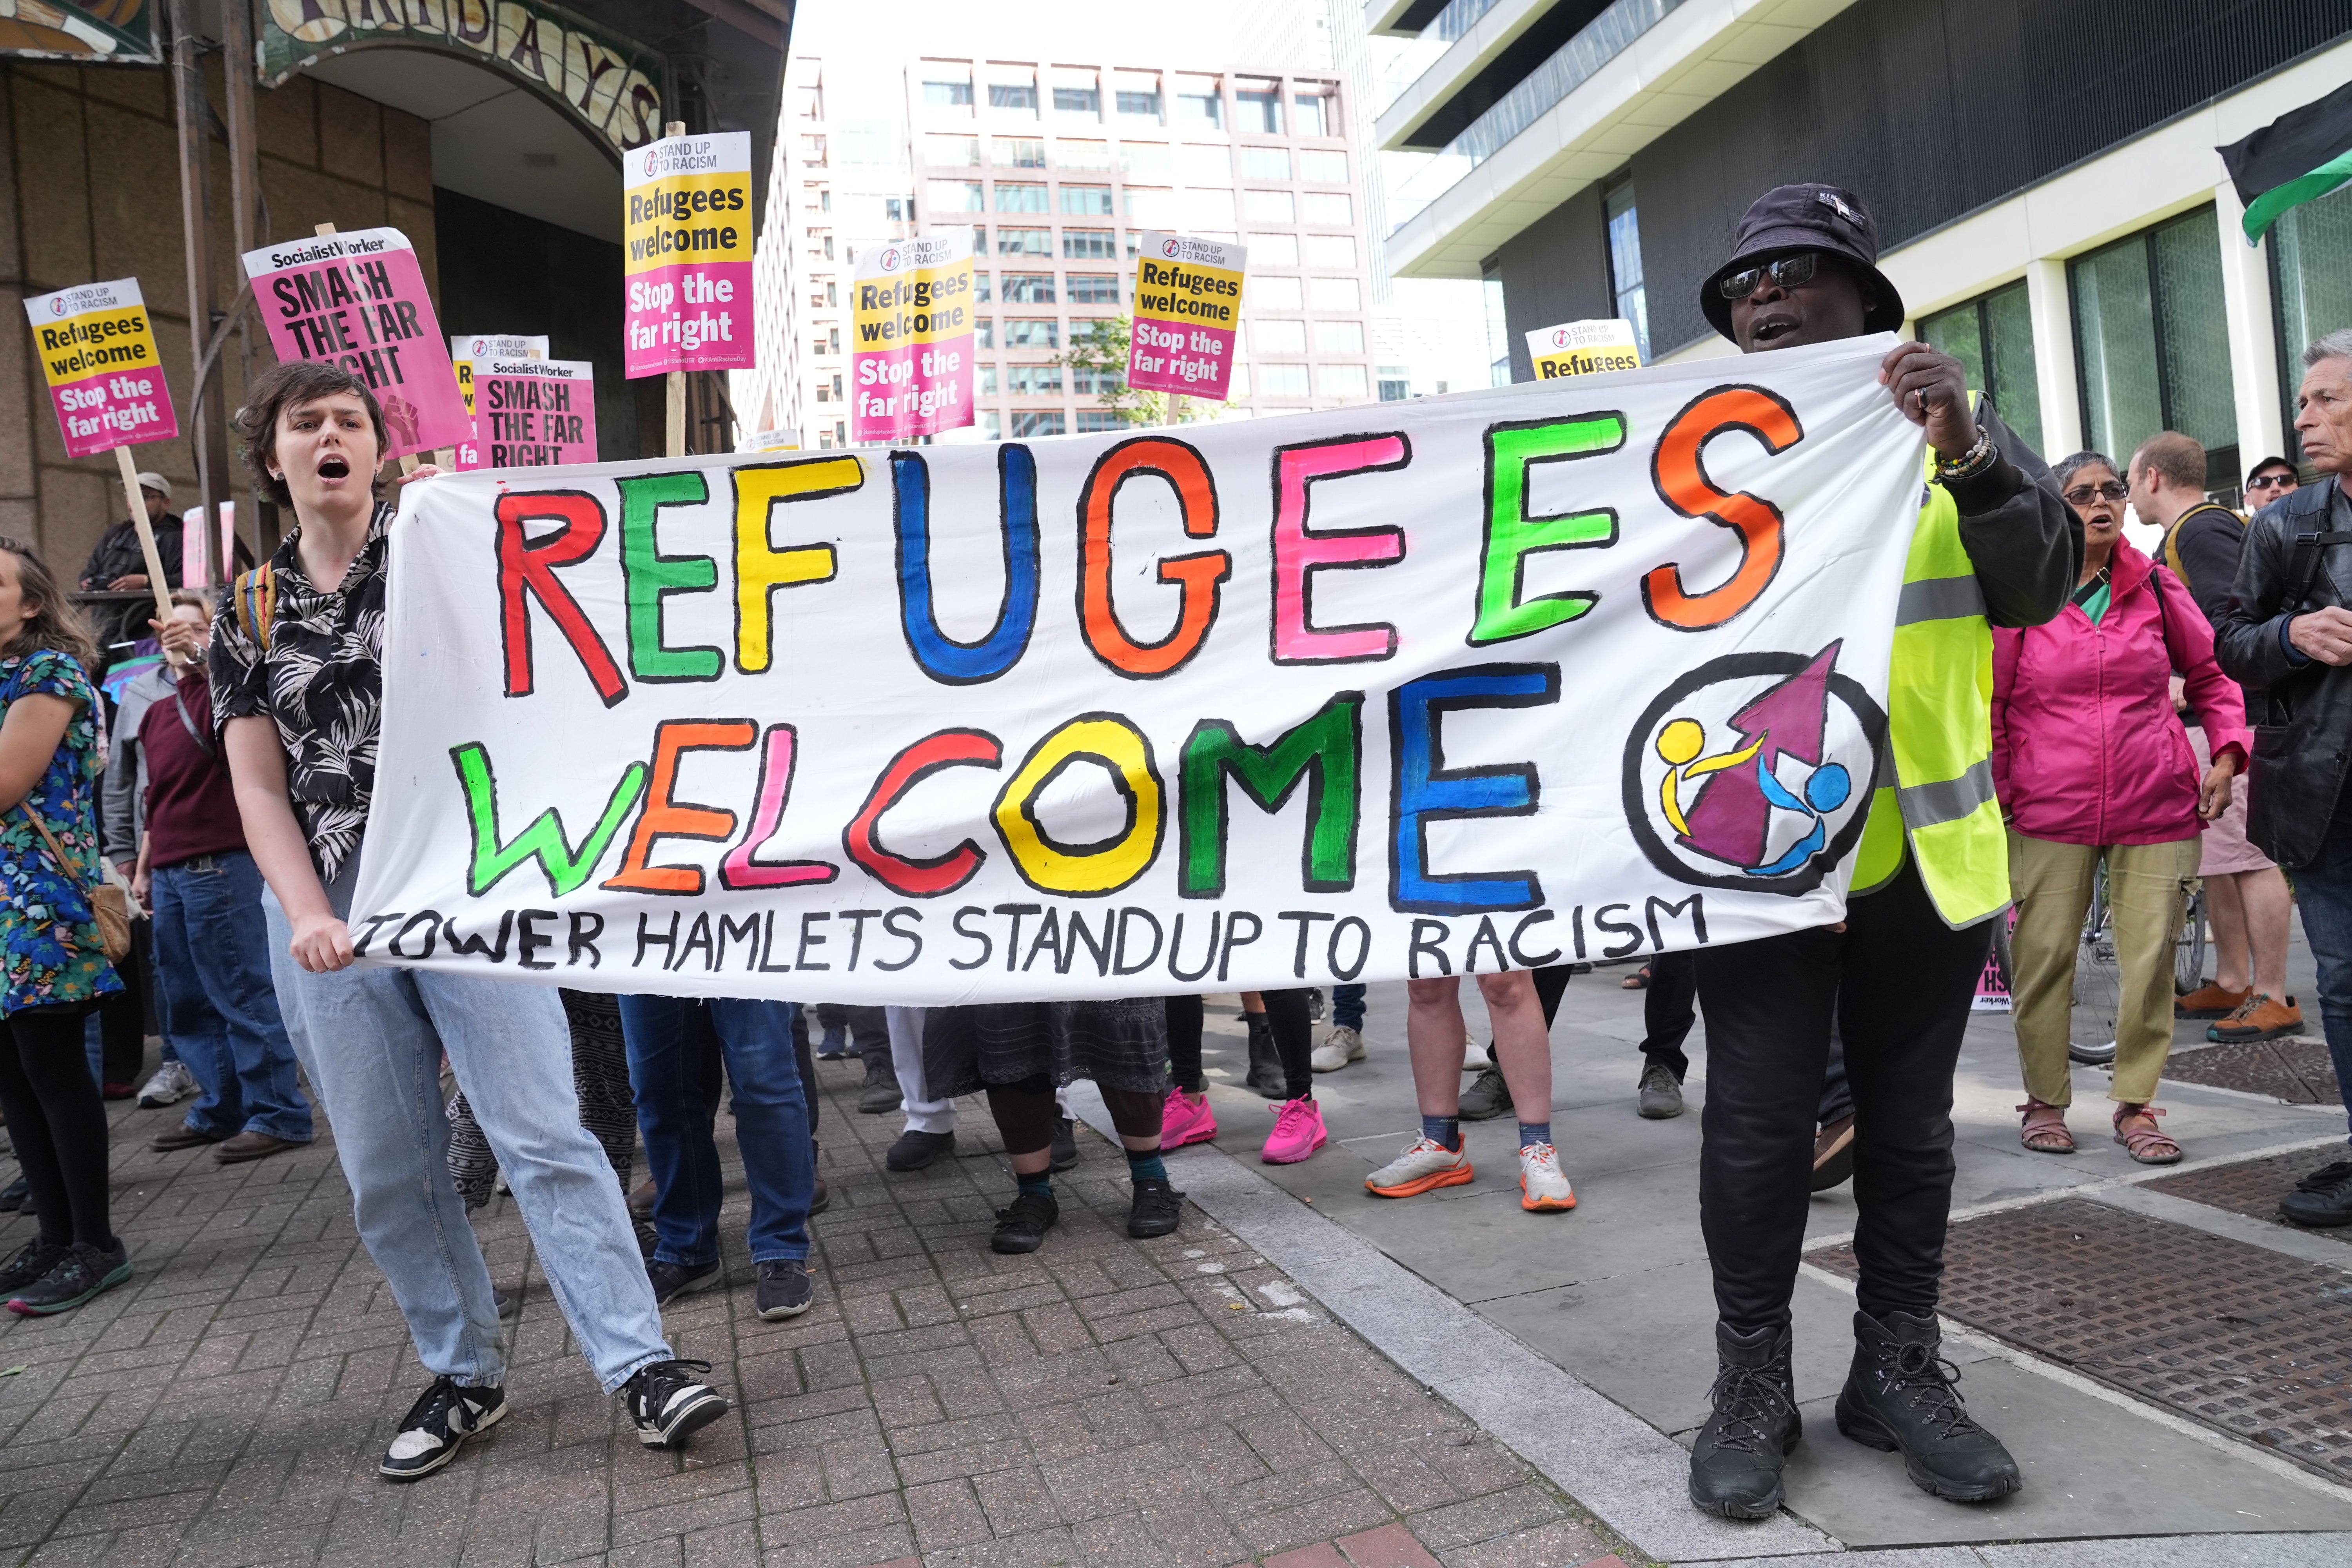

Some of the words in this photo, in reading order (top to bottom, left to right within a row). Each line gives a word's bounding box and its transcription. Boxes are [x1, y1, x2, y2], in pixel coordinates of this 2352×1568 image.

[659, 143, 691, 159] STAND
[695, 142, 711, 154] UP
[659, 159, 669, 172] TO
[673, 155, 717, 170] RACISM
[630, 187, 744, 225] Refugees
[630, 225, 737, 261] welcome
[903, 242, 932, 256] STAND
[935, 240, 947, 251] UP
[903, 256, 911, 268] TO
[915, 250, 951, 264] RACISM
[1181, 250, 1191, 260] TO
[1195, 252, 1225, 265] RACISM
[1182, 241, 1208, 252] STAND
[1211, 245, 1222, 254] UP
[66, 288, 93, 302] STAND
[97, 288, 109, 297] UP
[273, 260, 394, 318] SMASH
[630, 281, 674, 314] Stop
[682, 272, 733, 304] the
[861, 273, 968, 311] Refugees
[1143, 263, 1238, 296] Refugees
[69, 301, 79, 312] TO
[81, 296, 118, 309] RACISM
[1141, 293, 1230, 321] welcome
[42, 317, 144, 350] Refugees
[285, 310, 358, 359] THE
[359, 300, 424, 344] FAR
[630, 319, 658, 350] far
[662, 311, 733, 350] right
[860, 307, 963, 341] welcome
[1136, 323, 1185, 354] Stop
[1190, 331, 1222, 355] the
[1572, 325, 1597, 336] STAND
[1599, 325, 1608, 333] UP
[1574, 336, 1585, 345] TO
[1588, 334, 1615, 343] RACISM
[51, 343, 146, 376] welcome
[859, 359, 914, 388] Stop
[921, 349, 960, 377] the
[1134, 349, 1165, 373] far
[1169, 355, 1218, 383] right
[1541, 355, 1636, 379] Refugees
[60, 386, 107, 412] Stop
[110, 376, 153, 399] the
[488, 380, 570, 412] SMASH
[858, 391, 898, 417] far
[903, 379, 958, 417] right
[67, 416, 100, 438] far
[102, 401, 160, 431] right
[488, 412, 535, 441] THE
[543, 414, 584, 443] FAR
[459, 445, 477, 464] fa
[492, 445, 562, 468] RIGHT
[493, 383, 1805, 709] REFUGEES
[449, 661, 1562, 916] WELCOME
[353, 909, 604, 970] TOWER
[633, 904, 923, 973] HAMLETS
[1278, 911, 1371, 982] TO
[1409, 893, 1708, 978] RACISM
